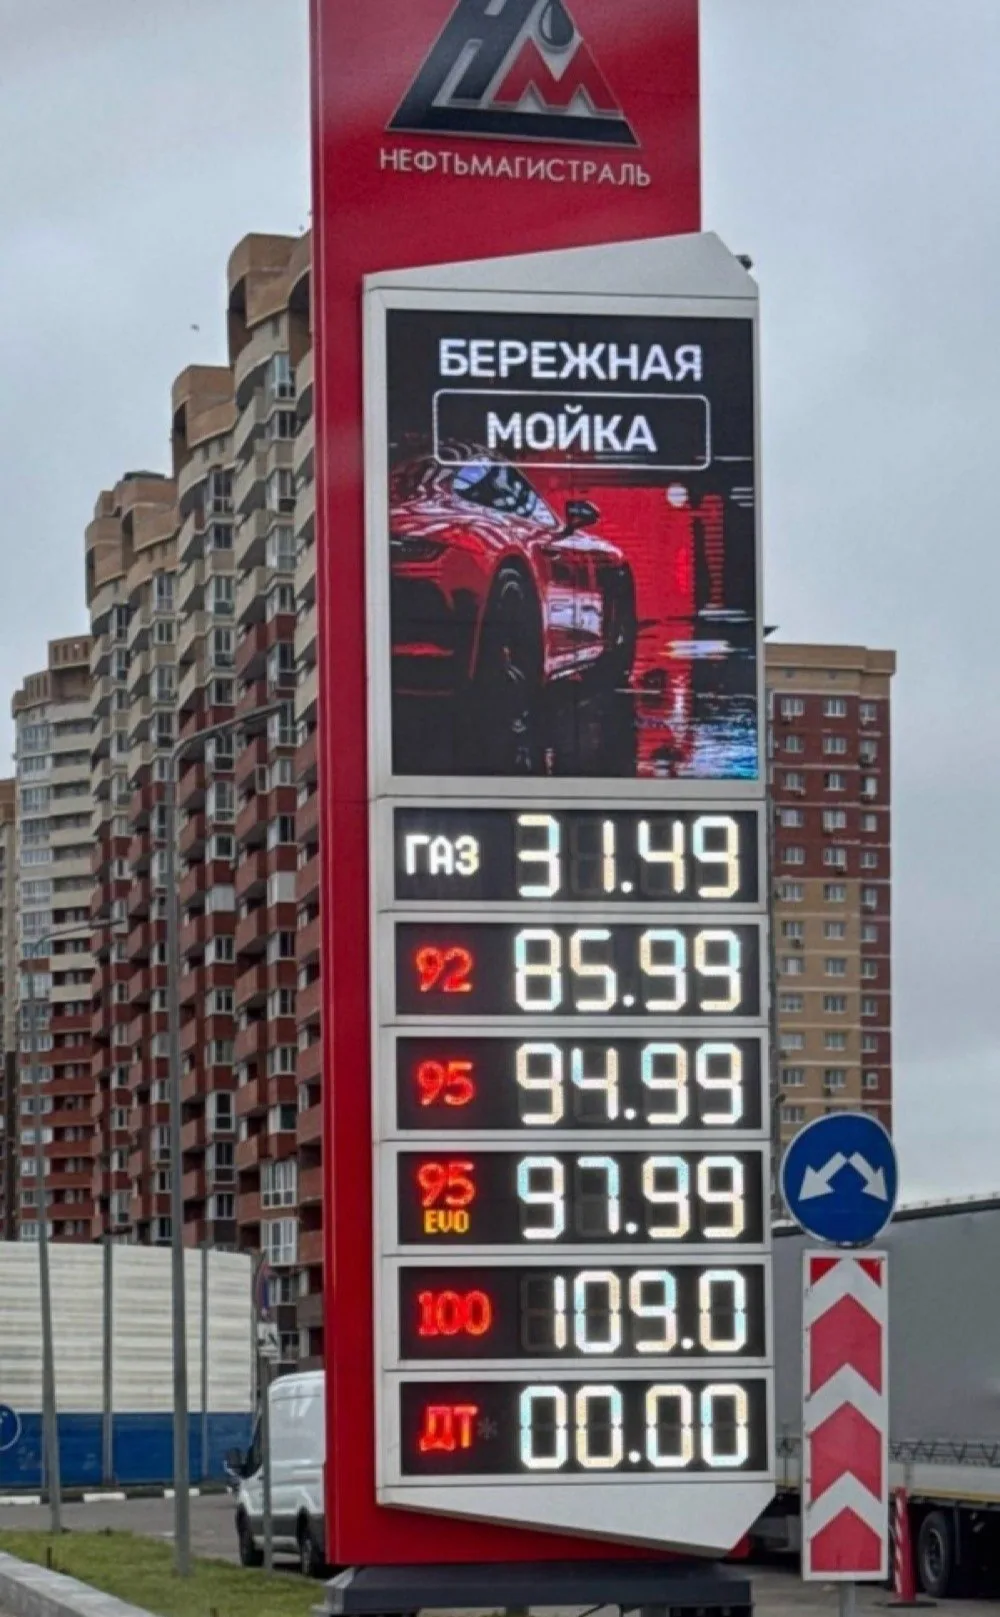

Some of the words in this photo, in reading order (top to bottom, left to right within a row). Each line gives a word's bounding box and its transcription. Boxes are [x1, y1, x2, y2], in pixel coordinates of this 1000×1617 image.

[380, 148, 652, 188] НЕФТЬМАГИСТРАЛЬ
[438, 338, 703, 383] БЕРЕЖНАЯ
[486, 404, 658, 453] МОЙКА
[405, 834, 480, 876] ГАЗ
[517, 814, 740, 899] 31.49
[415, 946, 473, 992] 92
[514, 928, 742, 1013] 85.99
[417, 1060, 476, 1106] 95
[516, 1042, 744, 1126] 94.99
[417, 1160, 476, 1207] 95
[517, 1155, 745, 1240] 97.99
[424, 1209, 470, 1235] EVO
[418, 1290, 493, 1337] 100
[553, 1269, 747, 1354] 109.0
[519, 1383, 750, 1470] 00.00
